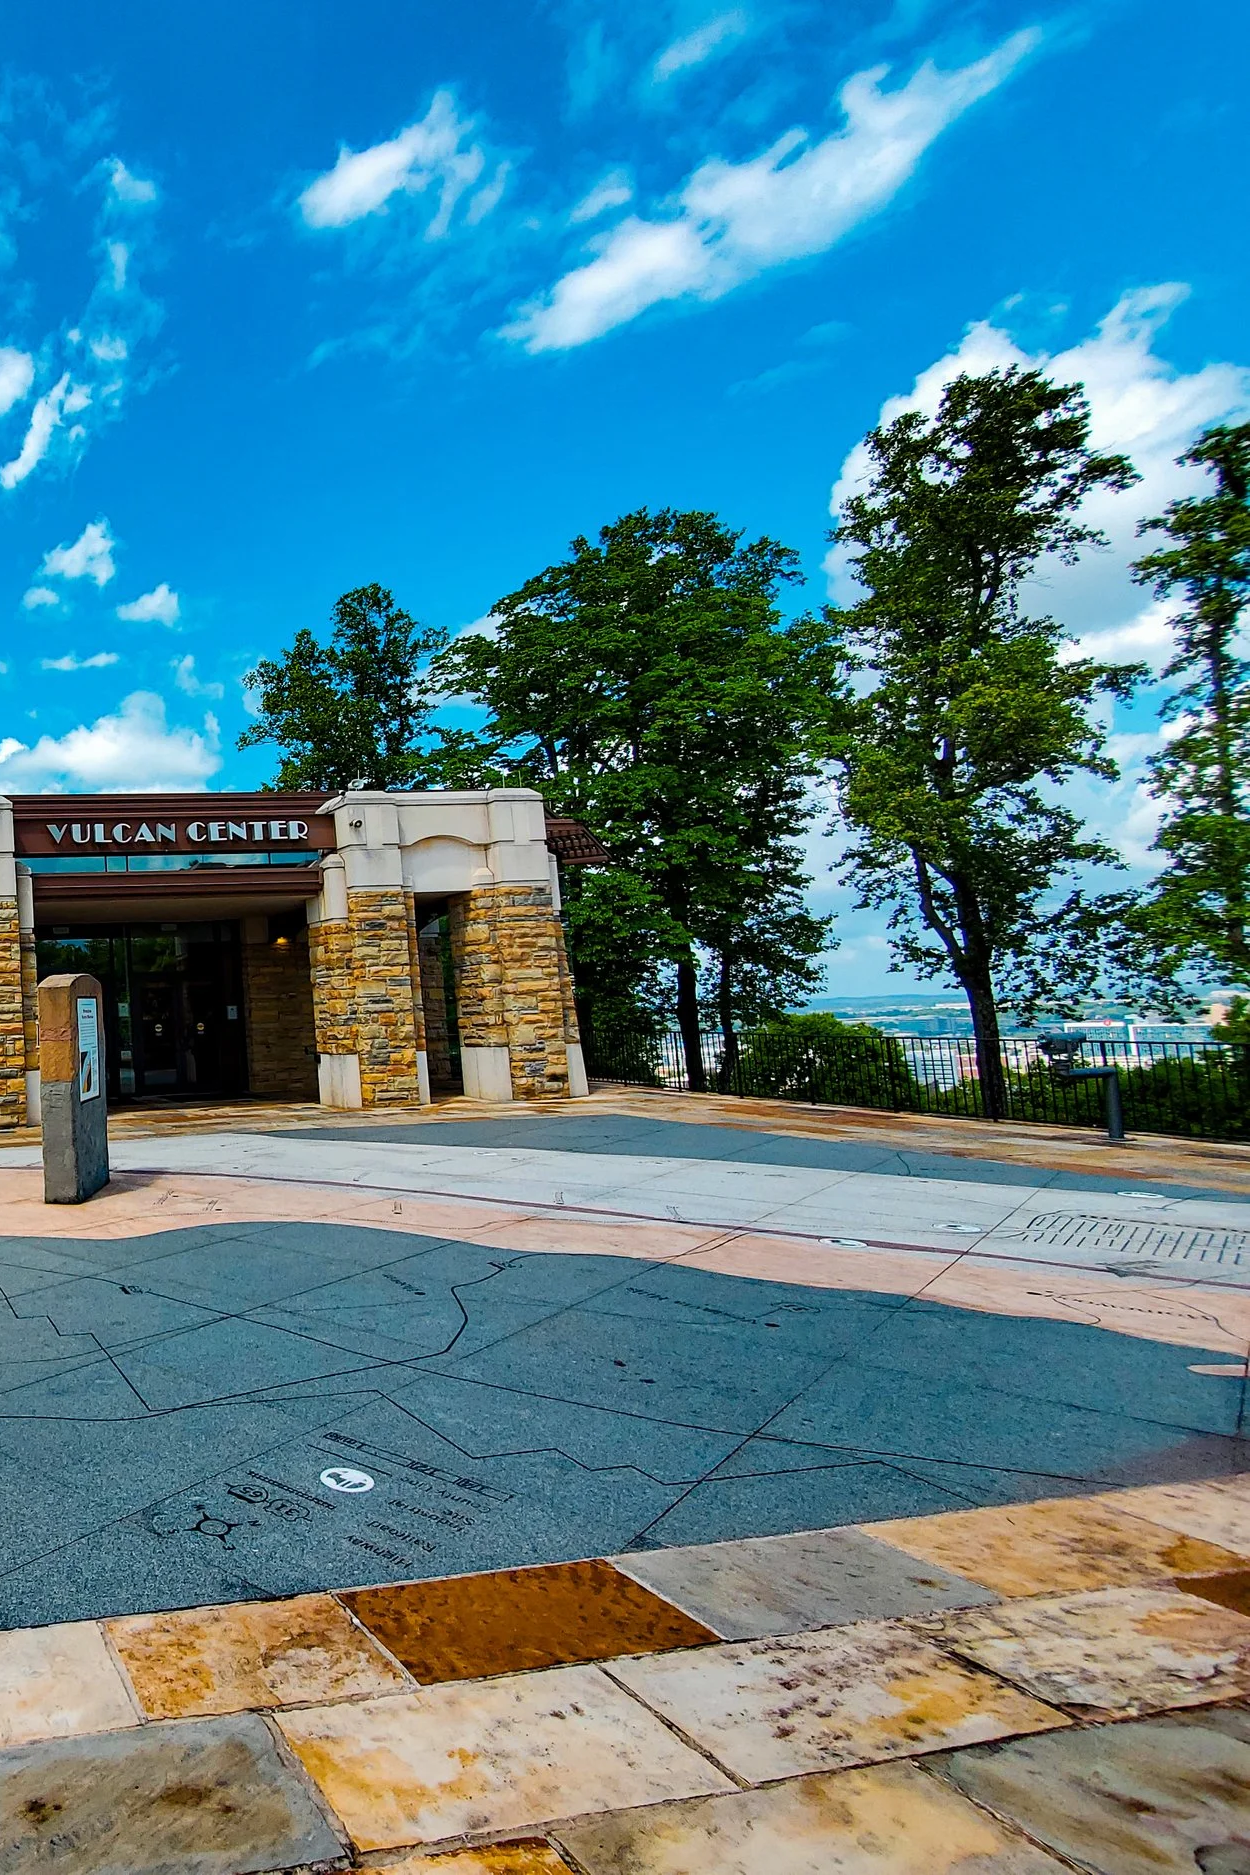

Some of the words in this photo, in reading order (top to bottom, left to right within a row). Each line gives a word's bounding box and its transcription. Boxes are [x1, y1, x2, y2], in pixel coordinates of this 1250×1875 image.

[46, 822, 176, 844] VULCAN
[186, 820, 308, 842] CENTER
[239, 1487, 264, 1499] 65
[437, 1489, 491, 1514] County
[273, 1502, 301, 1517] 31
[442, 1509, 476, 1527] Site
[366, 1520, 438, 1553] Railroad
[342, 1534, 414, 1570] Highway
